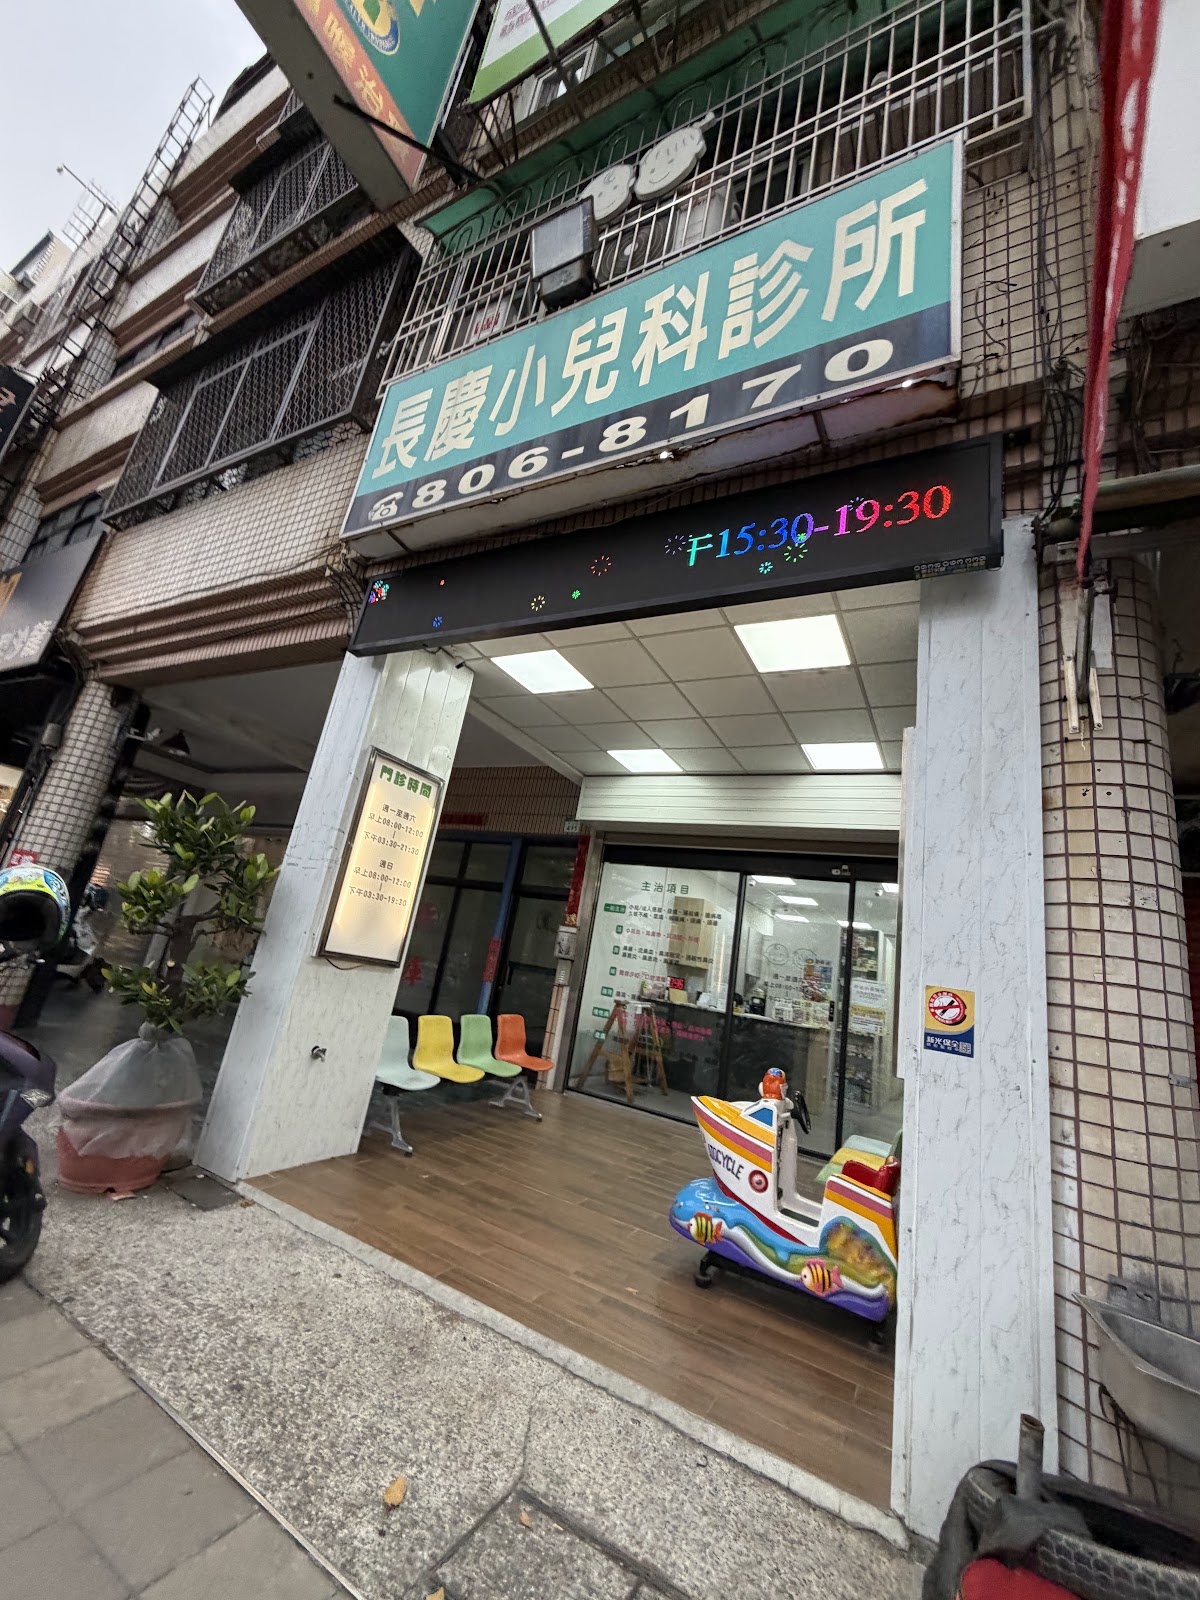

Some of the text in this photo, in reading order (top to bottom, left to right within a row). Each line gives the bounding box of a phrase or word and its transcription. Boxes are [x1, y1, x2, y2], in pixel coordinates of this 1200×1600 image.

[372, 178, 928, 480] 長慶小兒科診所
[412, 339, 894, 511] 806-8170
[379, 764, 432, 799] 門診時間
[382, 803, 417, 823] 週一至週六
[368, 812, 424, 838] 早上08:00-12:00
[364, 830, 419, 856] 下午03:30-21:30
[379, 859, 393, 870] 週日
[353, 866, 411, 889] 早上08:00-12:00
[640, 881, 689, 895] 主治項目
[349, 885, 407, 907] 下午03:30-19:30
[927, 1035, 959, 1048] 新光保全
